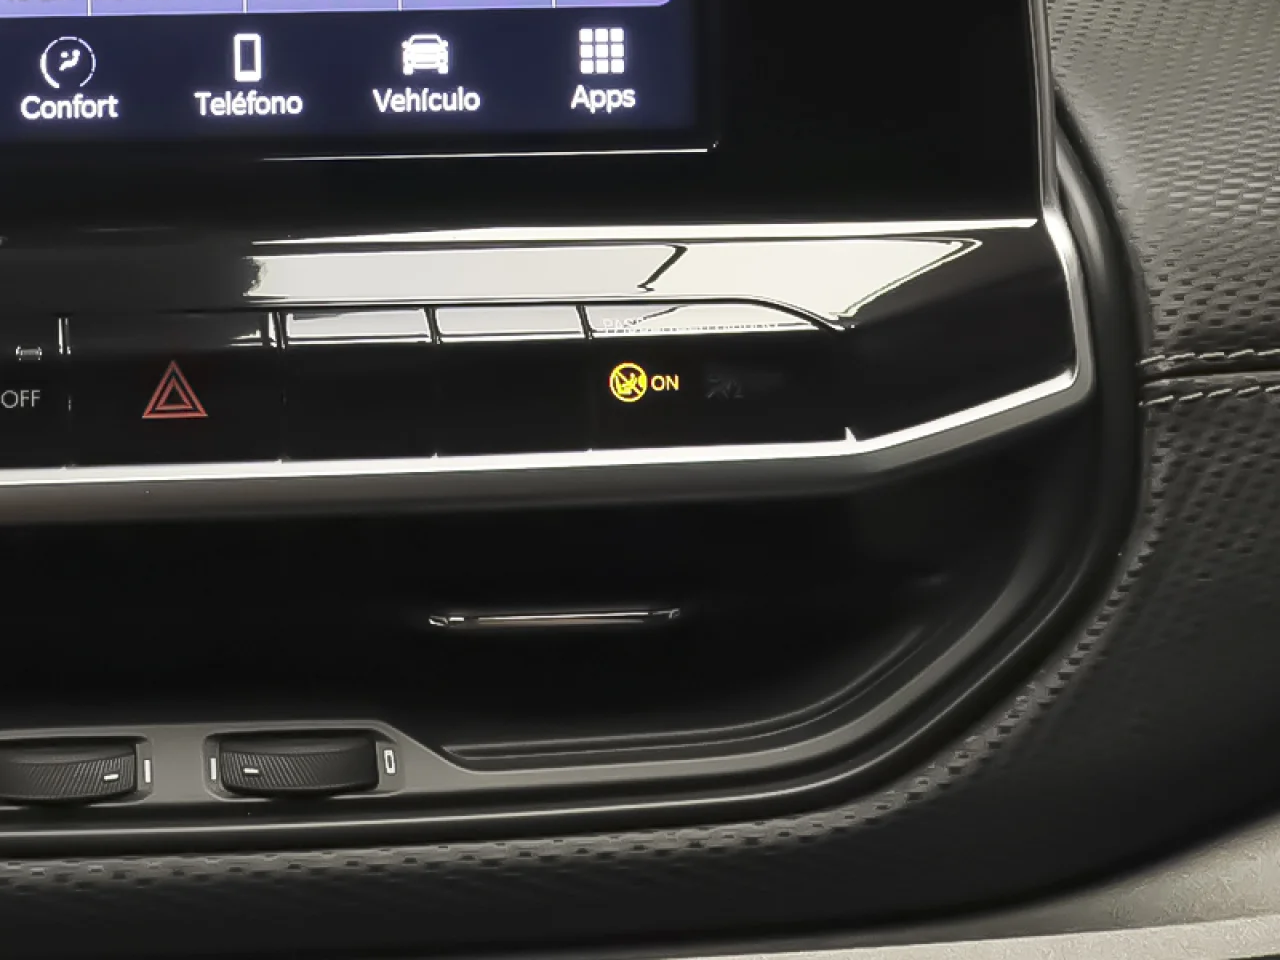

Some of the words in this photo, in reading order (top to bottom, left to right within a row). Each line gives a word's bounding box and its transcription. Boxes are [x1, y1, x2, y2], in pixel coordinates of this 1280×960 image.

[20, 94, 119, 120] Confort
[194, 90, 303, 116] Teléfono
[372, 87, 481, 113] Vehículo
[570, 85, 636, 112] Apps
[651, 375, 679, 391] ON
[0, 390, 41, 409] OFF
